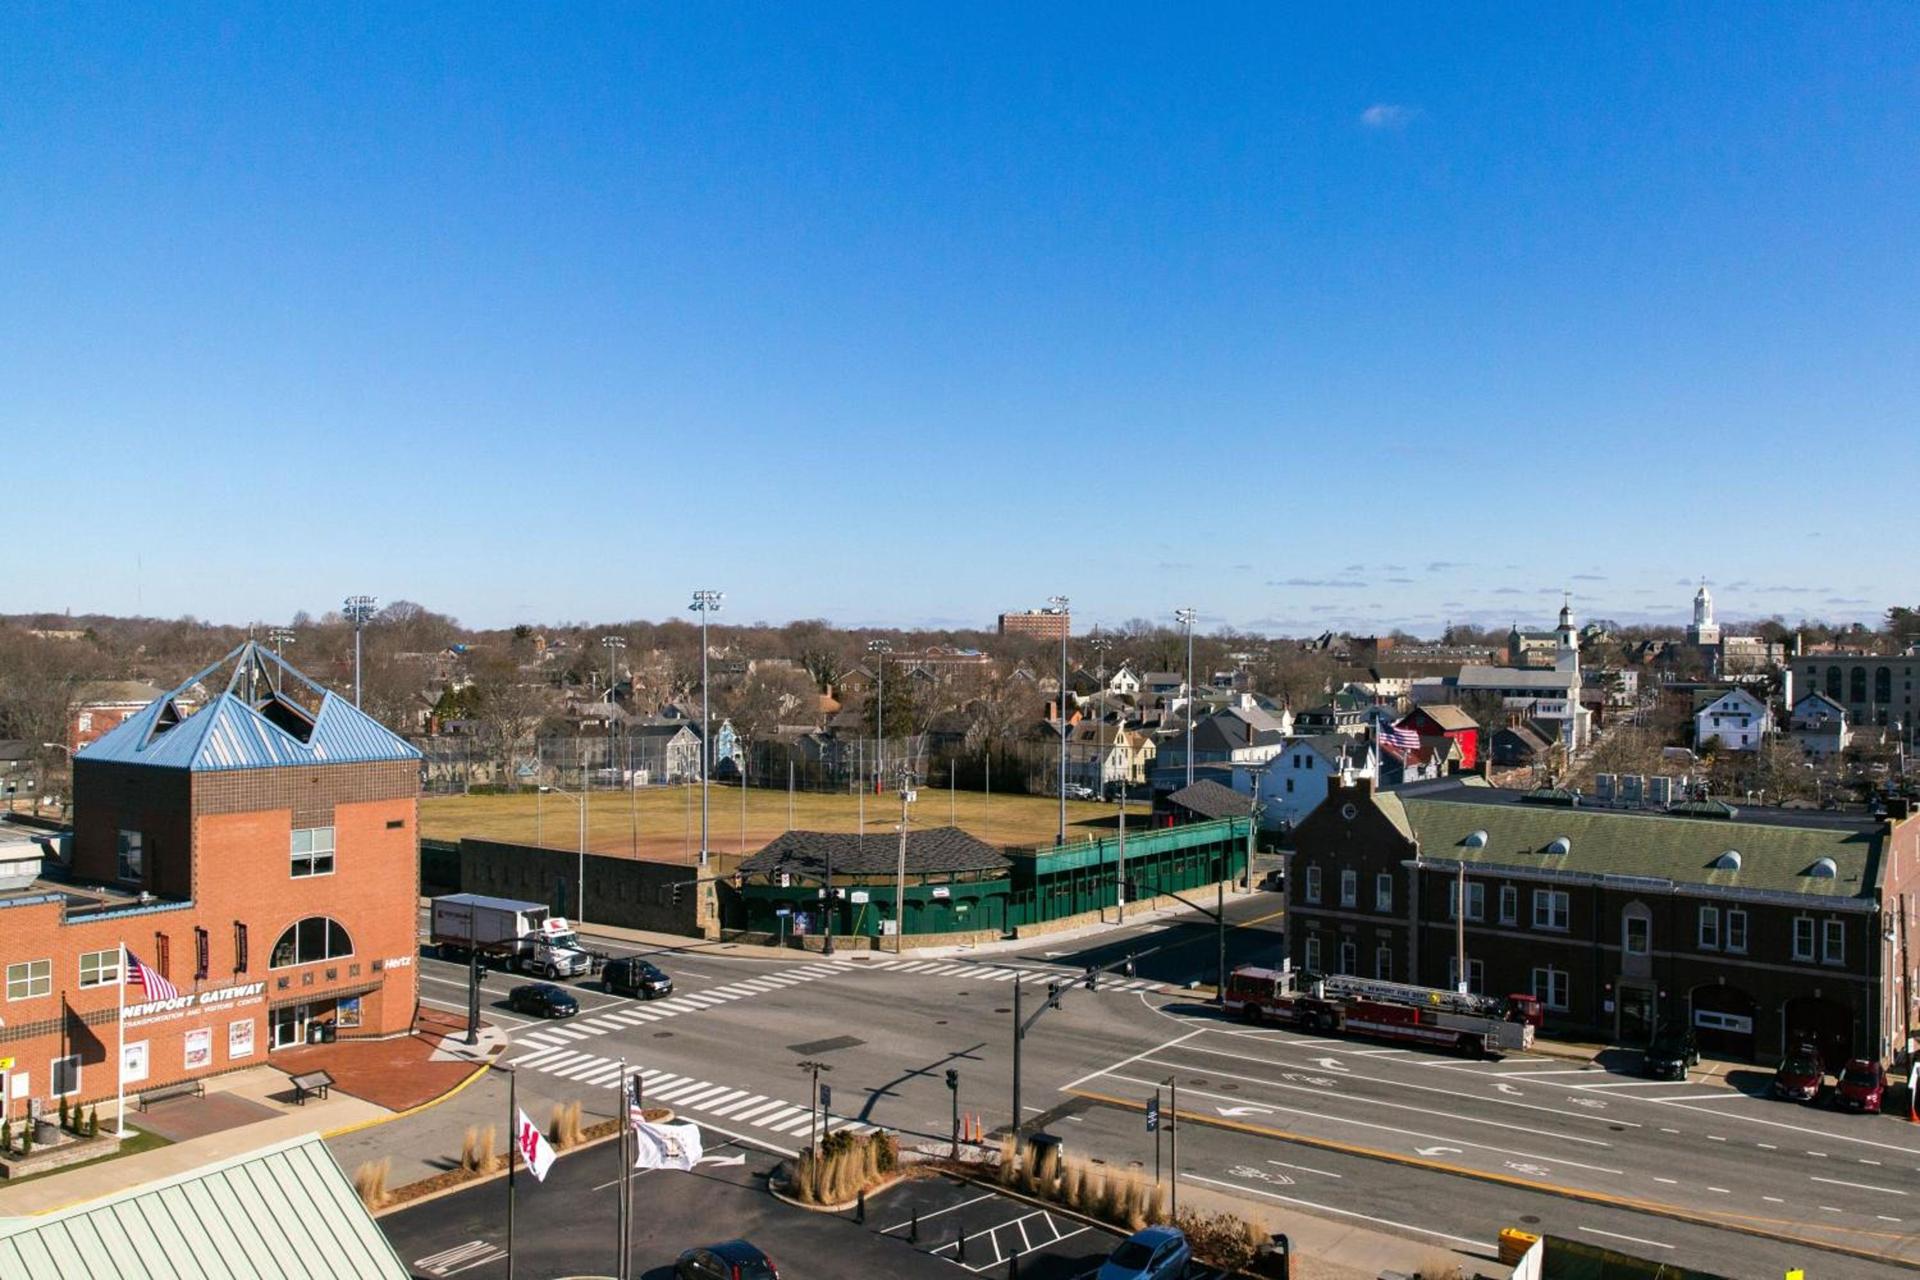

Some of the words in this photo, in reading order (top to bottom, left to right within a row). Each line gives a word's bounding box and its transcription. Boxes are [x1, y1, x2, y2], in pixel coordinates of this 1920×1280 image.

[384, 956, 411, 969] Hertz
[123, 996, 195, 1018] NEWPORT
[200, 982, 264, 1004] GATEWAY
